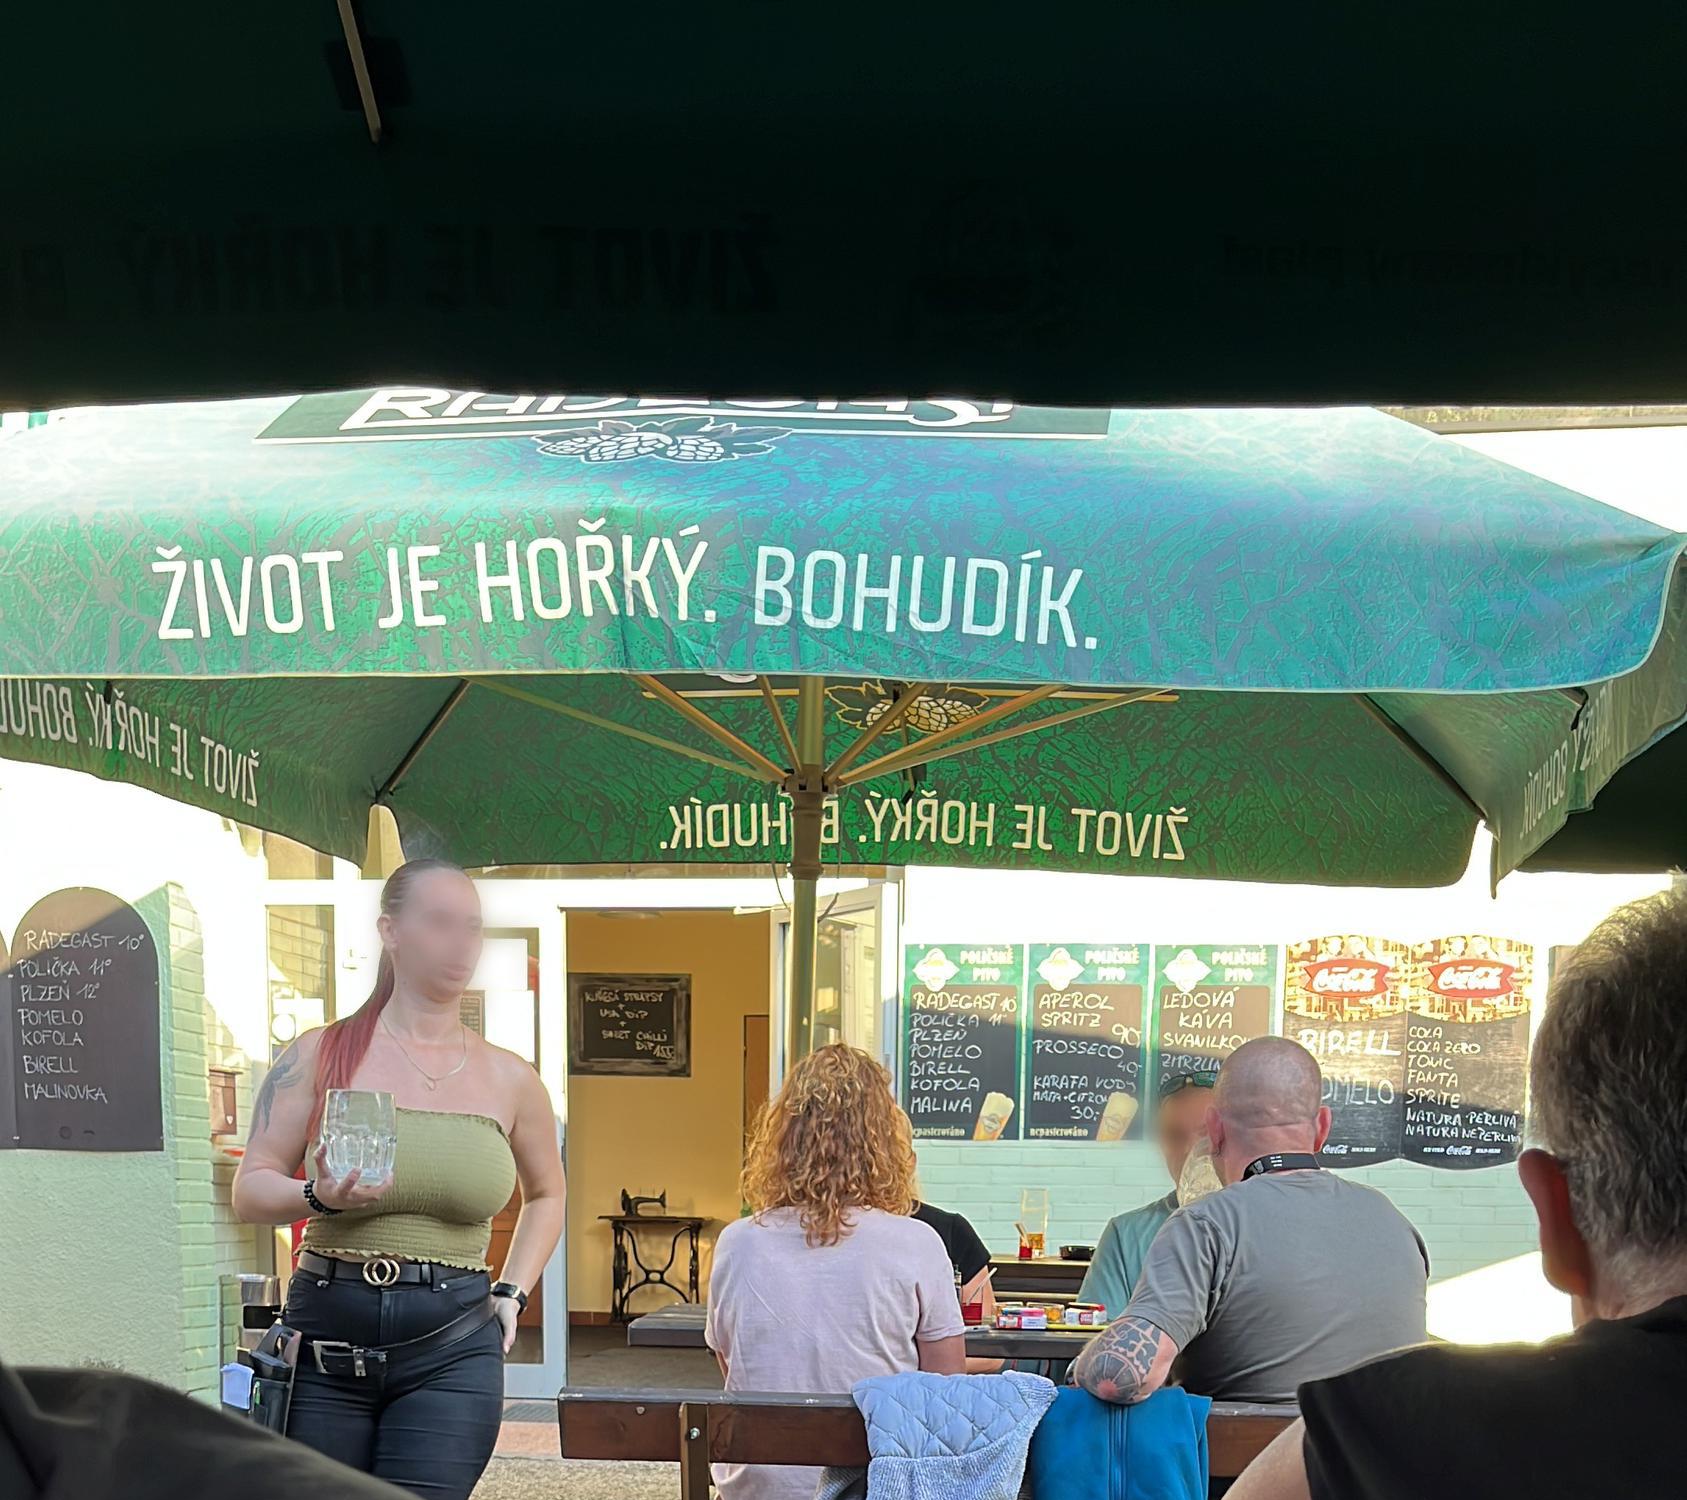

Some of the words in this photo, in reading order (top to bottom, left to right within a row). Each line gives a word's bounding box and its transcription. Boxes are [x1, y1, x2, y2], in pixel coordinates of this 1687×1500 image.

[151, 545, 344, 640] ŽIVOT
[377, 543, 447, 629] JE
[474, 517, 718, 624] HOŘKÝ.
[754, 546, 1097, 650] BOHUDÍK.
[24, 929, 116, 951] RADEGAST
[17, 956, 81, 978] POLIČKA
[21, 979, 70, 1002] PLZEŇ
[1163, 986, 1240, 1009] LEDOVÁ
[913, 992, 1001, 1011] RADEGAST
[1039, 992, 1115, 1011] APEROL
[17, 1008, 84, 1026] POMELO
[910, 1012, 980, 1028] POLIČKA
[1041, 1012, 1101, 1028] SPRITZ
[1179, 1008, 1233, 1029] KÁVA
[21, 1029, 84, 1046] KOFOLA
[1298, 1028, 1402, 1056] BIRELL
[1409, 1026, 1443, 1039] COLA
[909, 1044, 982, 1059] POMELO
[1033, 1039, 1124, 1059] PROSSECO
[1407, 1041, 1441, 1053] COLA
[1445, 1041, 1481, 1055] ZERO
[23, 1055, 79, 1074] BIRELL
[910, 1061, 971, 1076] BIRELL
[910, 1078, 981, 1092] KOFOLA
[1033, 1075, 1088, 1090] KARAFA
[1095, 1076, 1137, 1093] VODY
[1407, 1069, 1459, 1088] FANTA
[24, 1082, 108, 1104] MALINOVKA
[1322, 1074, 1395, 1105] OMELO
[1405, 1088, 1461, 1109] SPRITE
[910, 1096, 973, 1114] MALINA
[1406, 1107, 1462, 1126] NATURA
[1405, 1123, 1459, 1138] NATURA
